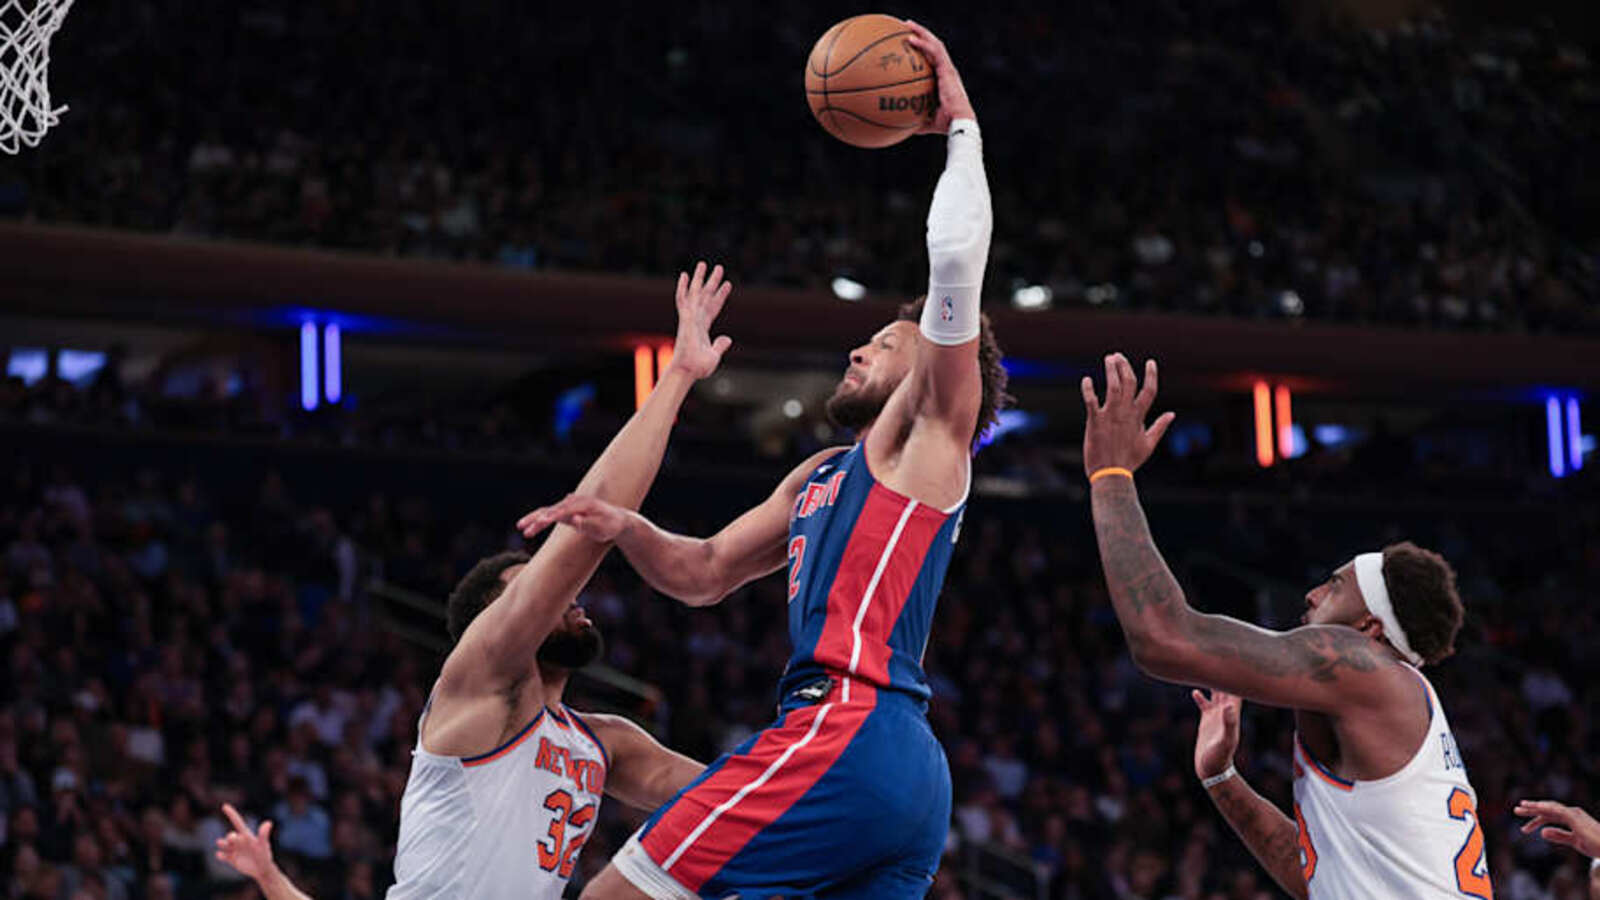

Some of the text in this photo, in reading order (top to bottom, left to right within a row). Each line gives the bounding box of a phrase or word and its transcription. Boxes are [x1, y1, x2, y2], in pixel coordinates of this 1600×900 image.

[788, 535, 807, 601] 2
[535, 736, 605, 797] NEW YO
[536, 788, 596, 879] 32
